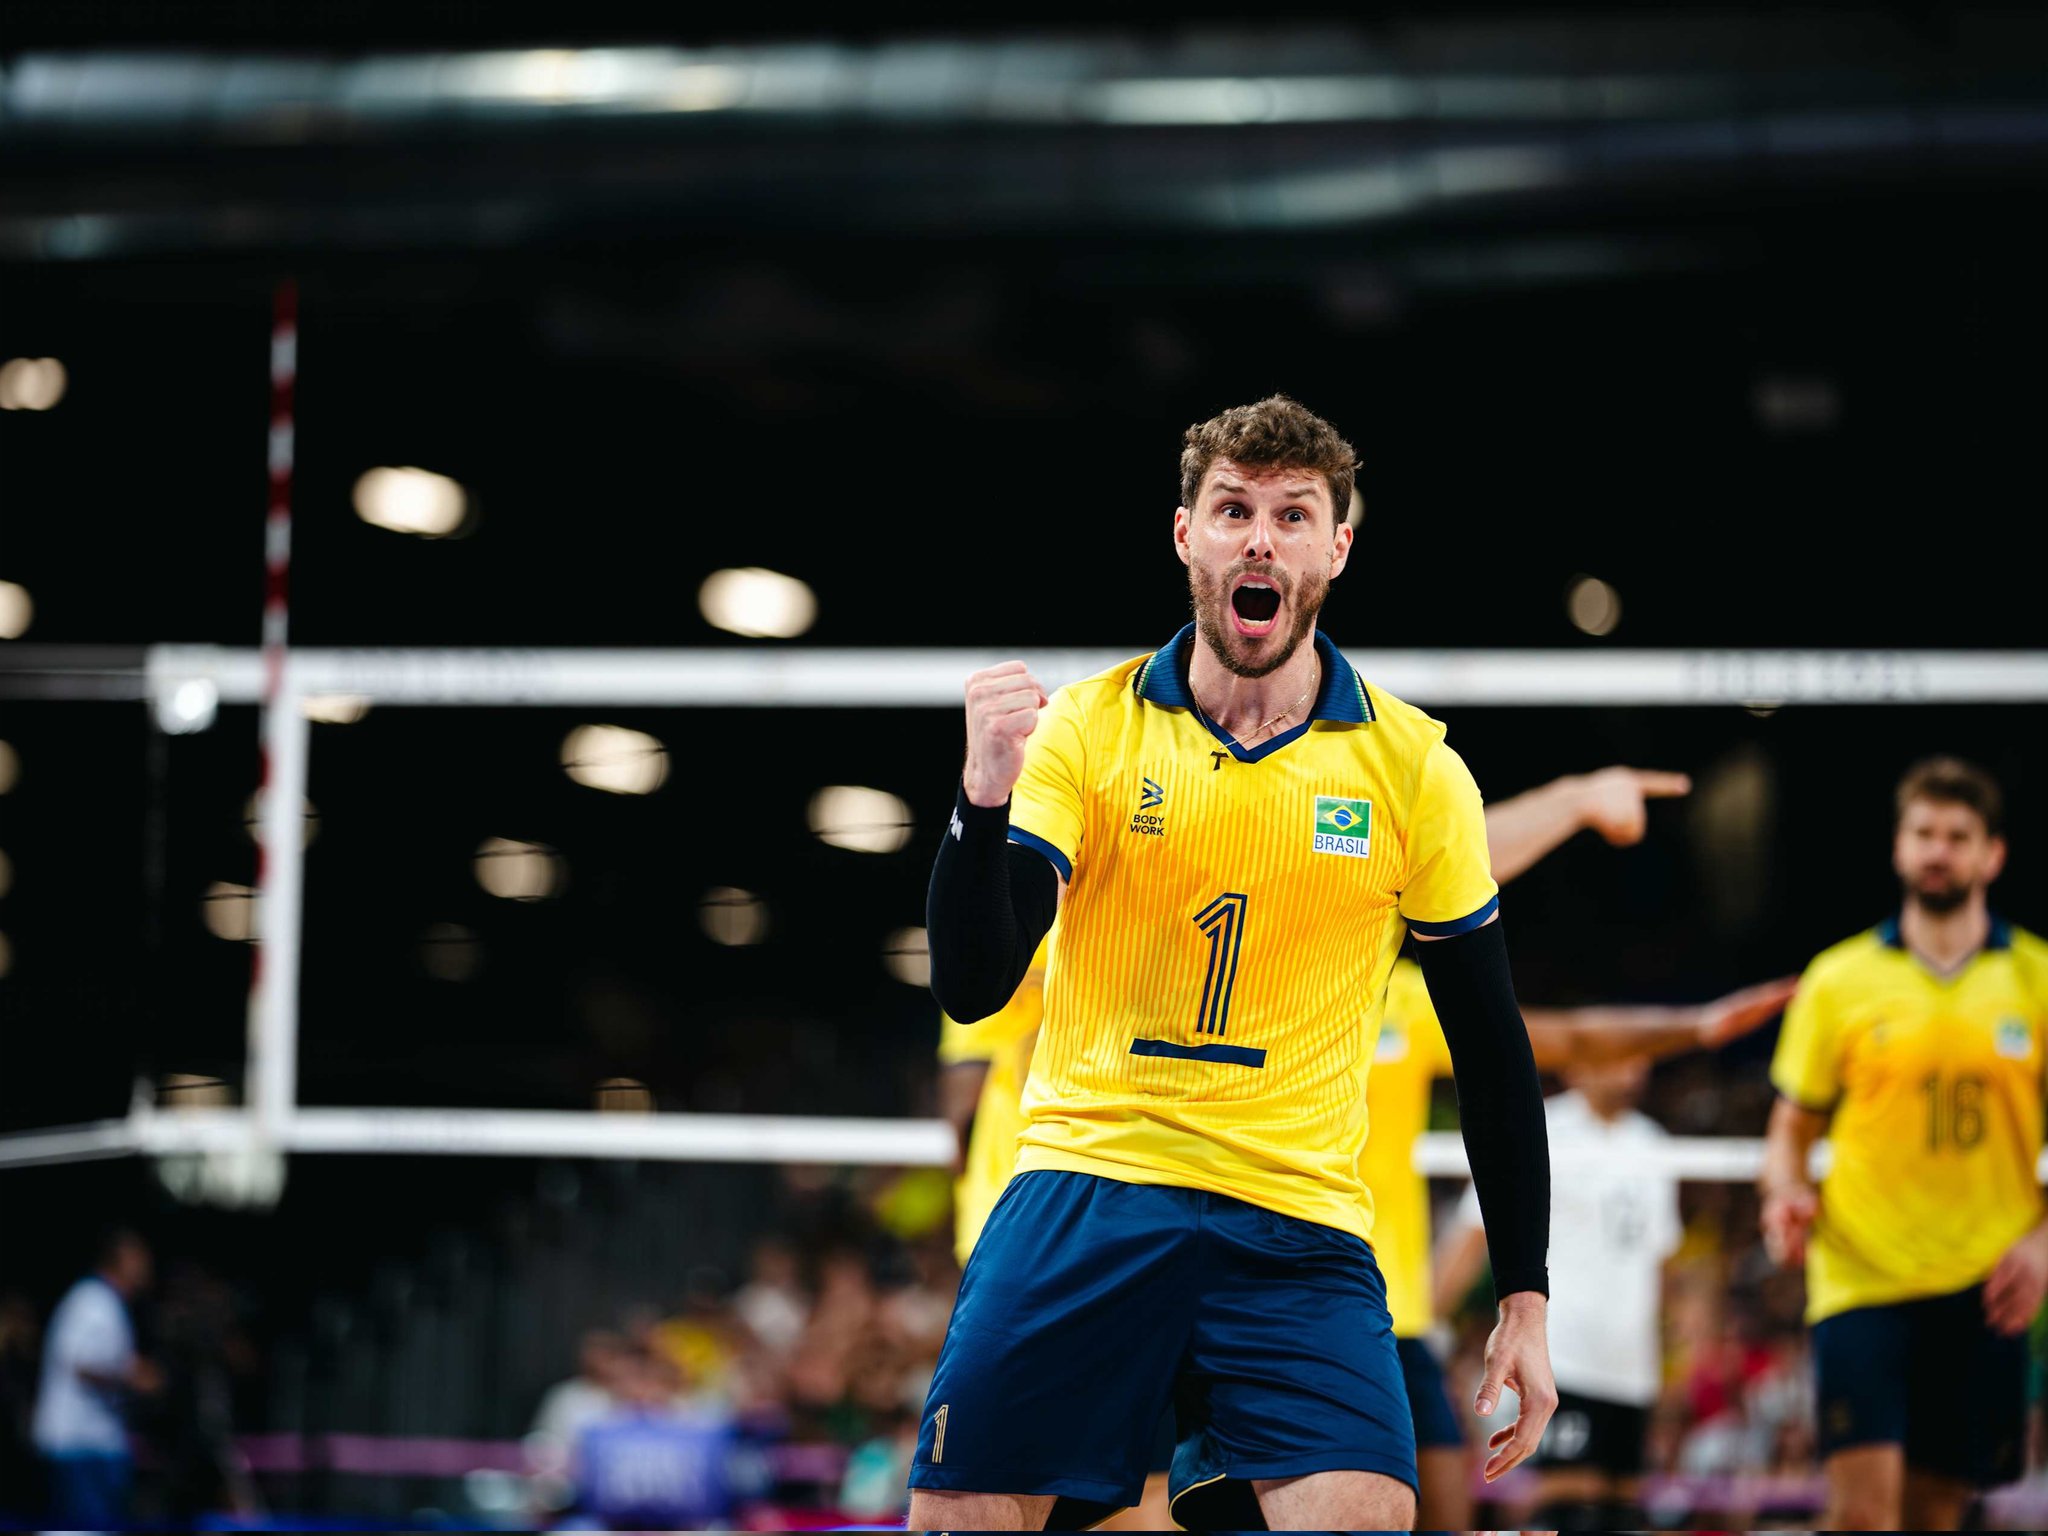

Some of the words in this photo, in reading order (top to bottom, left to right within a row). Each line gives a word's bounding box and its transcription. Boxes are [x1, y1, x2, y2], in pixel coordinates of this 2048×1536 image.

[1130, 823, 1165, 836] WORK
[1134, 814, 1165, 826] BODY
[1314, 835, 1368, 856] BRASIL
[1192, 892, 1248, 1036] 1
[1921, 1071, 1986, 1154] 16
[931, 1404, 949, 1464] 1
